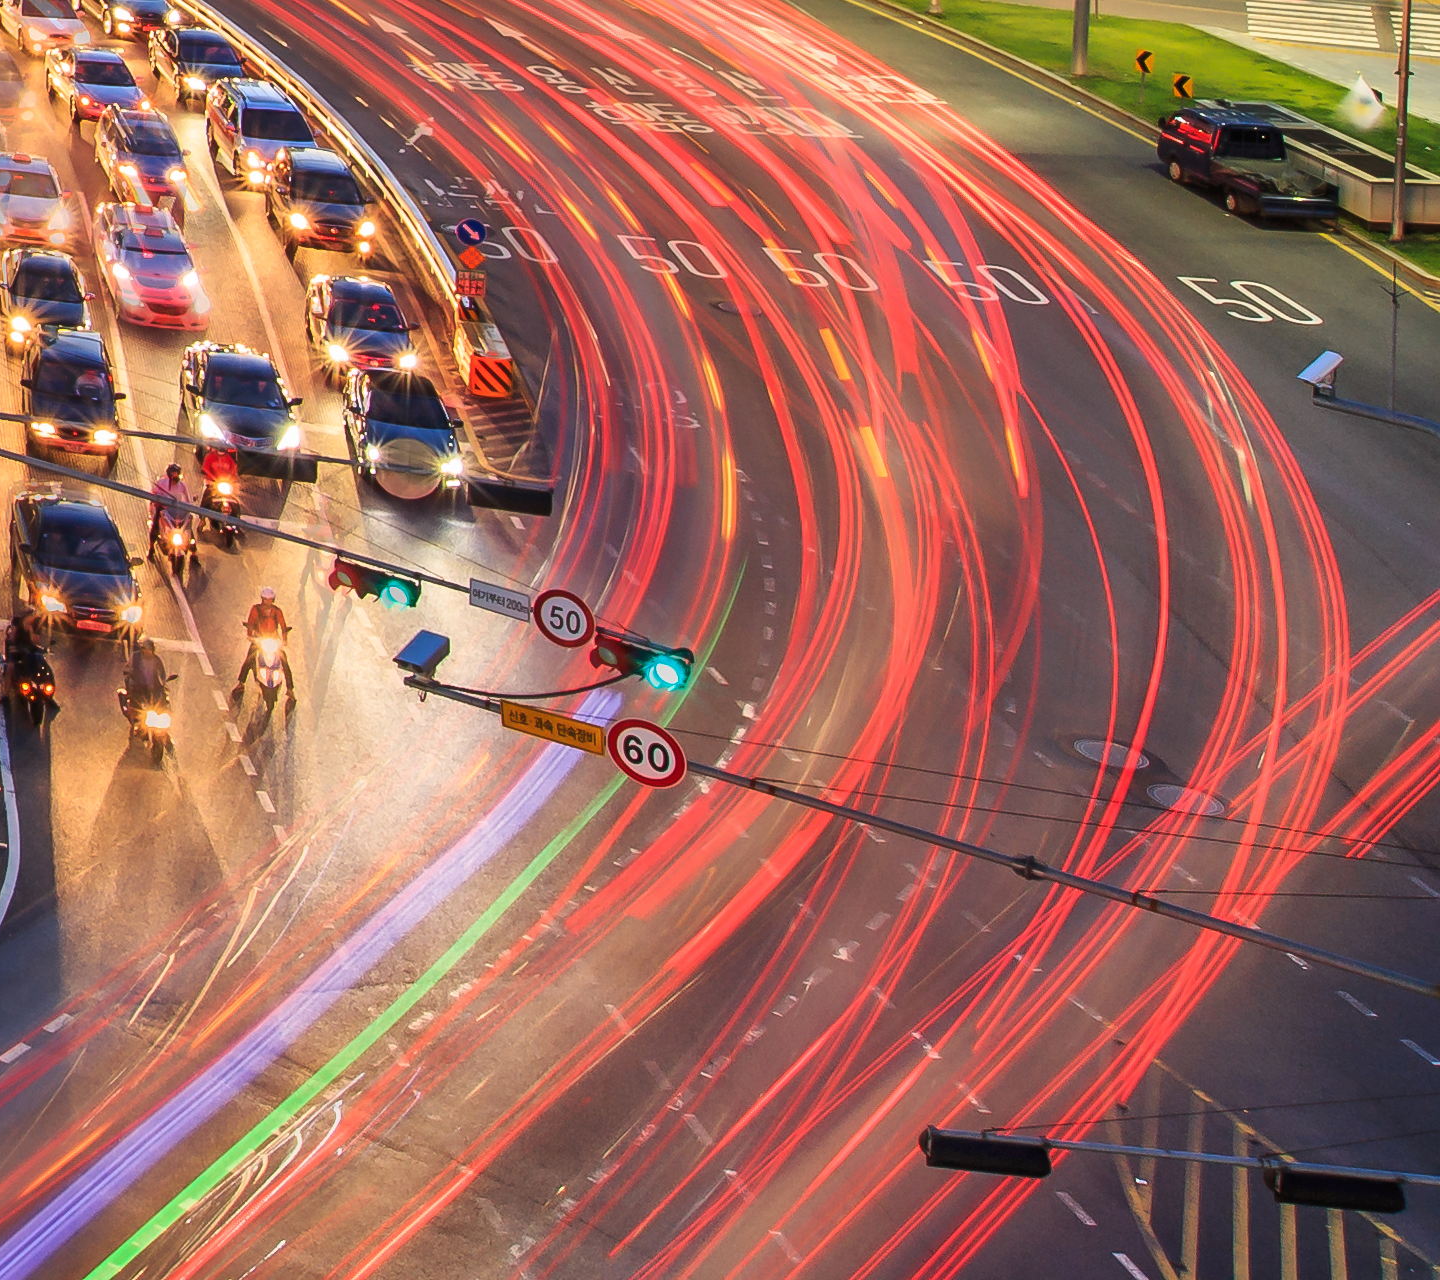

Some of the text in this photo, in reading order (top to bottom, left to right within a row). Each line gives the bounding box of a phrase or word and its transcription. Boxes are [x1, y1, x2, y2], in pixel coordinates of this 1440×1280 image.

[616, 234, 728, 279] 50
[761, 246, 879, 291] 50
[922, 259, 1051, 305] 50
[1175, 275, 1324, 326] 50
[472, 589, 506, 607] 여기부터
[549, 605, 581, 635] 50
[556, 722, 597, 746] 단속장비
[622, 734, 671, 773] 60
